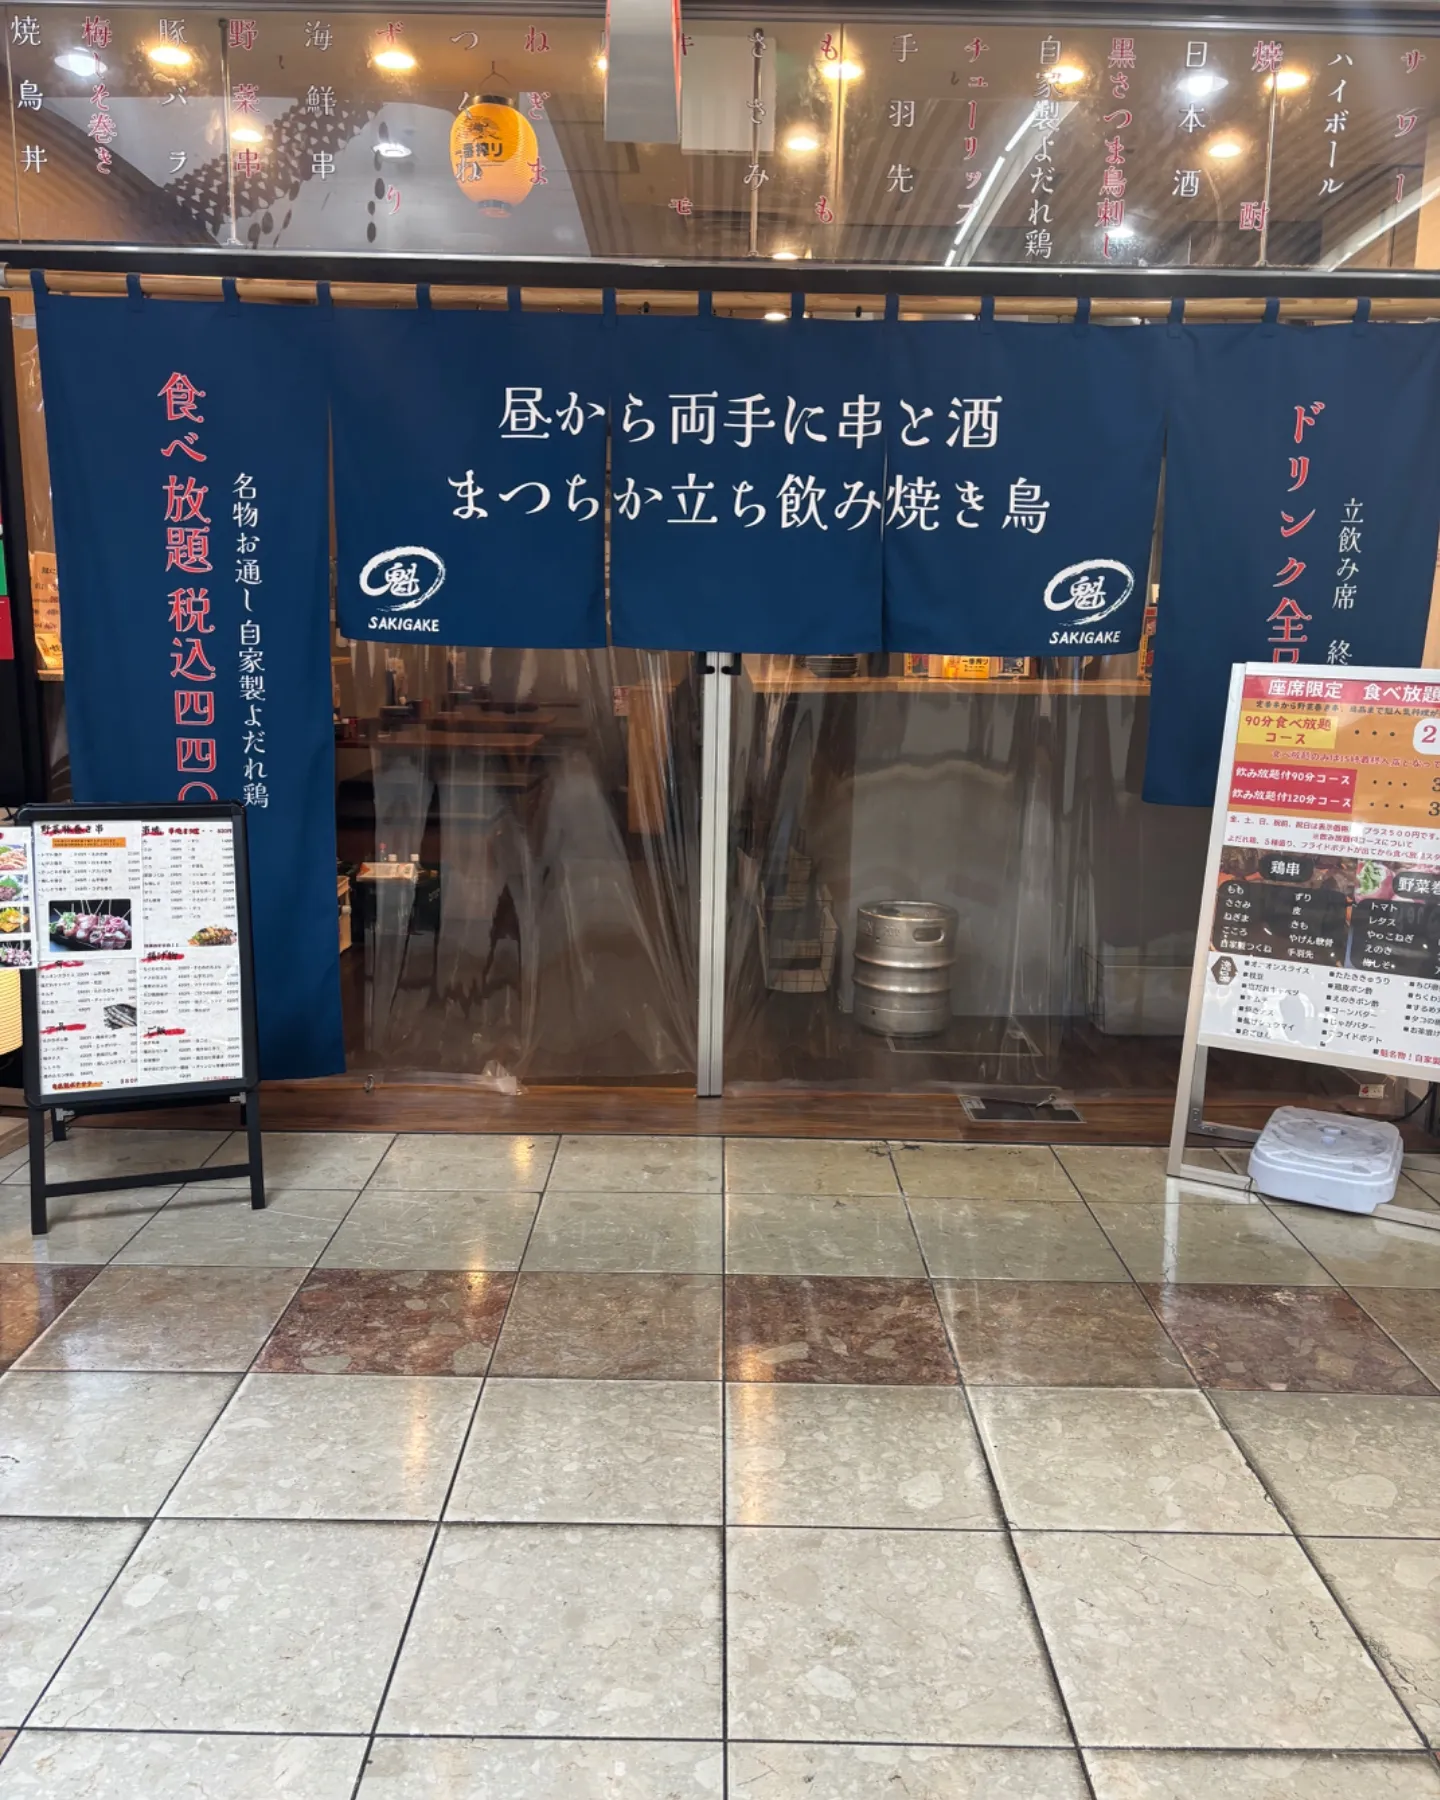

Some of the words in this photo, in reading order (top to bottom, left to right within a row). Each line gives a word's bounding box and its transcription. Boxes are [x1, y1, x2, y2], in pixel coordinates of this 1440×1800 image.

[10, 15, 47, 174] 焼鳥丼
[82, 15, 117, 175] 梅しそ巻き
[159, 18, 188, 174] 豚バラ
[228, 19, 261, 178] 野菜串
[304, 20, 337, 180] 海鮮串
[376, 21, 404, 215] ずり
[451, 30, 483, 183] つくね
[525, 25, 551, 186] ねぎま
[743, 32, 769, 190] ささみ
[815, 33, 838, 223] もも
[886, 33, 918, 193] 手羽先
[1024, 35, 1062, 259] 自家製よだれ鶏
[1172, 40, 1207, 198] 日本酒
[1238, 41, 1283, 232] 焼酎
[1318, 53, 1353, 196] ハイボール
[1394, 48, 1426, 203] サワー
[497, 385, 1004, 450] 昼から両手に串と酒
[447, 472, 1050, 535] まつちか立ち飲み焼き鳥
[367, 615, 440, 632] SAKIGAKE
[1049, 630, 1121, 645] SAKIGAKE
[1268, 679, 1344, 699] 座席限定
[1235, 766, 1350, 785] 飲み放題付90分コース
[1245, 716, 1331, 732] 90分食べ放題
[1265, 732, 1306, 745] コース
[1231, 788, 1351, 808] 飲み放題付120分コース
[1270, 860, 1300, 876] 鶏串
[1223, 912, 1250, 923] ねぎま
[1225, 899, 1251, 909] ささみ
[1365, 944, 1392, 955] えのき
[1369, 916, 1396, 927] レタス
[1371, 902, 1398, 912] トマト
